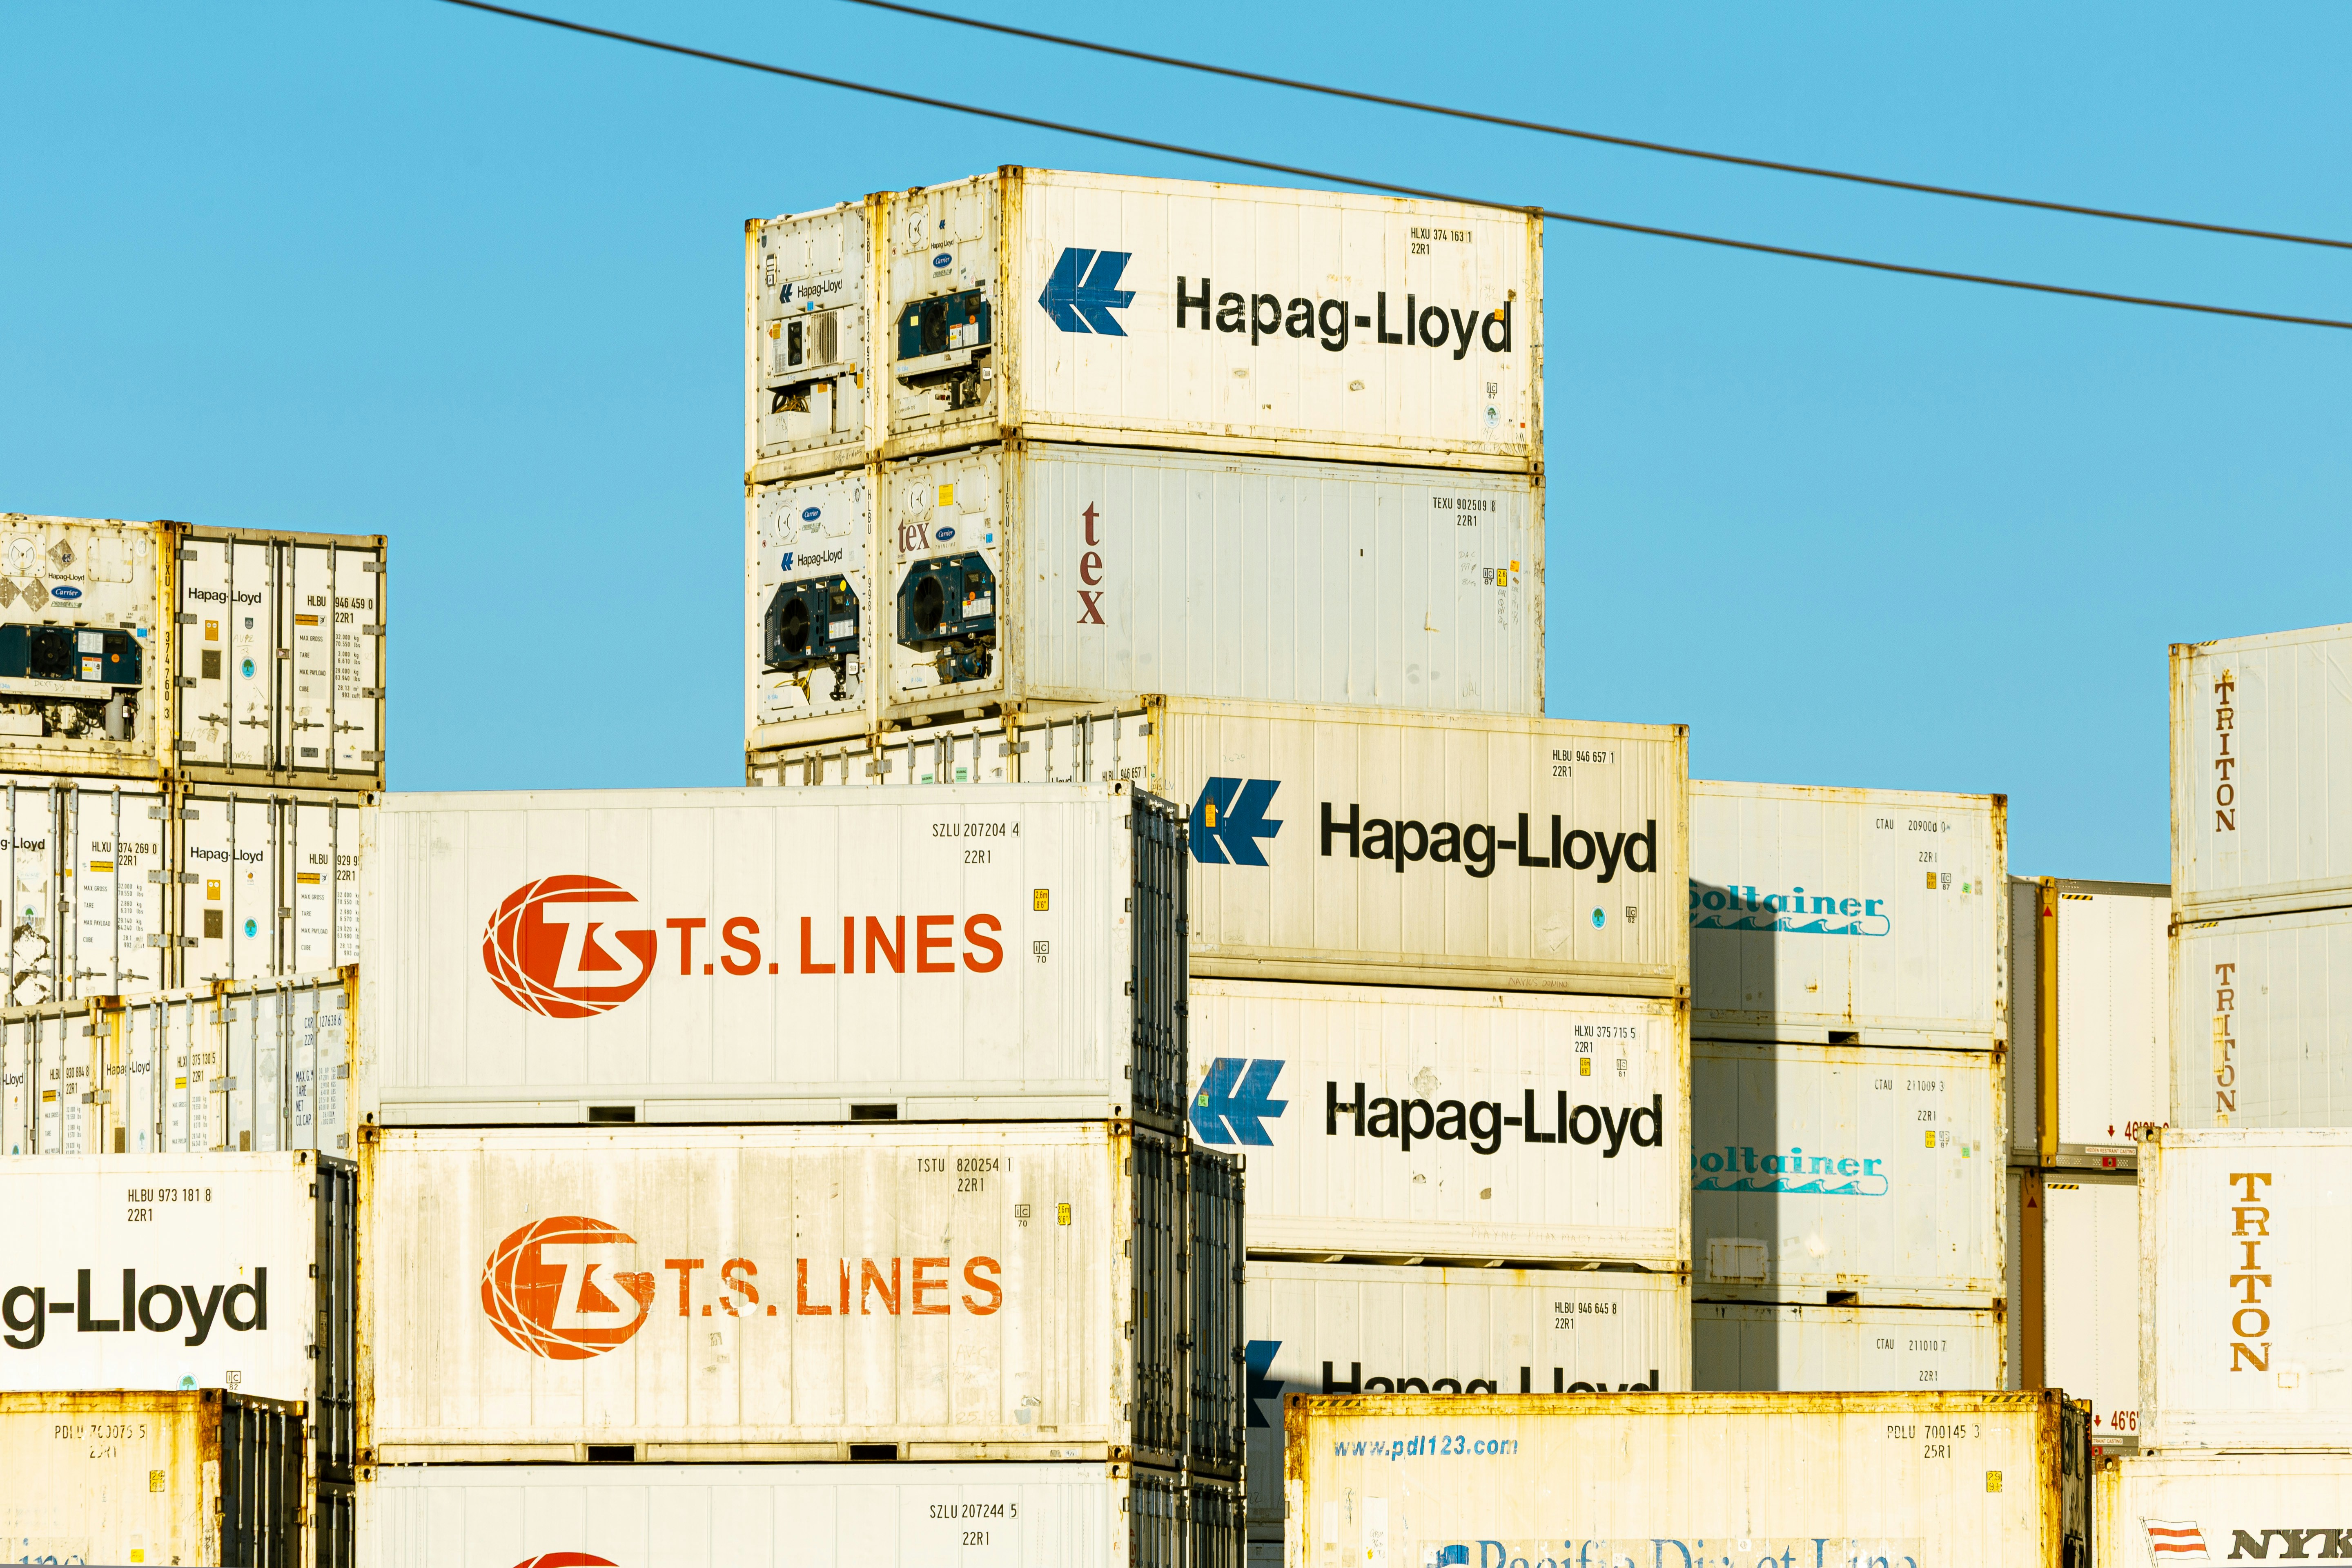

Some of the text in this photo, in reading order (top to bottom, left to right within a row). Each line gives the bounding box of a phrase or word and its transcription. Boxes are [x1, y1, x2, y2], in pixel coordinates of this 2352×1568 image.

[1411, 227, 1463, 241] HLXU 374 163
[1412, 243, 1429, 254] 22R1
[935, 256, 949, 265] Carrier
[797, 278, 842, 299] Hapag-Lloyd
[1177, 276, 1512, 360] Hapag-Lloyd
[1433, 497, 1494, 512] TEXU 902509 8
[804, 509, 819, 518] Carrier
[1457, 515, 1476, 526] 22R1
[898, 517, 930, 553] tex
[938, 530, 953, 539] Carrier
[798, 548, 842, 567] Hapag-Lloyd
[1077, 501, 1105, 624] tex
[49, 573, 84, 581] Hapag-Lloyd
[308, 595, 364, 608] HLBU 946 459
[336, 612, 353, 623] 22R1
[1553, 750, 1606, 763] HLBU 946 657
[2215, 681, 2235, 832] TRITON
[1121, 768, 1129, 779] 946
[1132, 767, 1140, 777] 657
[1553, 766, 1571, 777] 22R1
[933, 823, 1018, 837] SZLU 207204 4
[1876, 819, 1937, 832] CTAU 209000
[92, 842, 148, 853] HLXU 374 269
[1321, 802, 1656, 883] Hapag-Lloyd
[119, 855, 137, 866] 22R1
[310, 854, 350, 865] HLBU 929
[965, 850, 990, 863] 22R1
[1919, 852, 1936, 862] 22R1
[337, 870, 354, 881] 22R1
[666, 914, 1003, 976] T.S. LINES
[319, 1015, 341, 1027] 127638 6
[1575, 1025, 1635, 1038] HLXU 375 715 5
[1575, 1042, 1592, 1052] 22R1
[212, 1053, 215, 1063] 5
[76, 1067, 84, 1077] 884
[86, 1066, 89, 1076] 8
[193, 1071, 203, 1082] 22R1
[66, 1083, 77, 1094] 22R1
[296, 1085, 306, 1096] TARE
[1875, 1080, 1892, 1090] CTAU
[1327, 1081, 1662, 1158] Hapag-Lloyd
[1918, 1111, 1936, 1120] 22R1
[918, 1158, 998, 1172] TSTU 820254
[1691, 1146, 1882, 1176] oltainer
[958, 1178, 983, 1192] 22R1
[129, 1189, 210, 1202] HLBU 973 181 8
[128, 1209, 151, 1221] 22R1
[2230, 1173, 2272, 1371] TRITON
[665, 1254, 1002, 1318] T.S. LINES
[2, 1267, 267, 1349] g-Lloyd
[1555, 1302, 1616, 1314] HLBU 946 645 8
[1555, 1318, 1573, 1329] 22R1
[1877, 1339, 1938, 1351] CTAU 211010
[1920, 1371, 1937, 1381] 22R1
[1925, 1425, 1966, 1439] 700145
[1332, 1436, 1517, 1461] www.pdl123.com
[1924, 1445, 1950, 1458] 25R1
[930, 1504, 1016, 1518] SZLU 207244 5
[963, 1532, 988, 1545] 22R1
